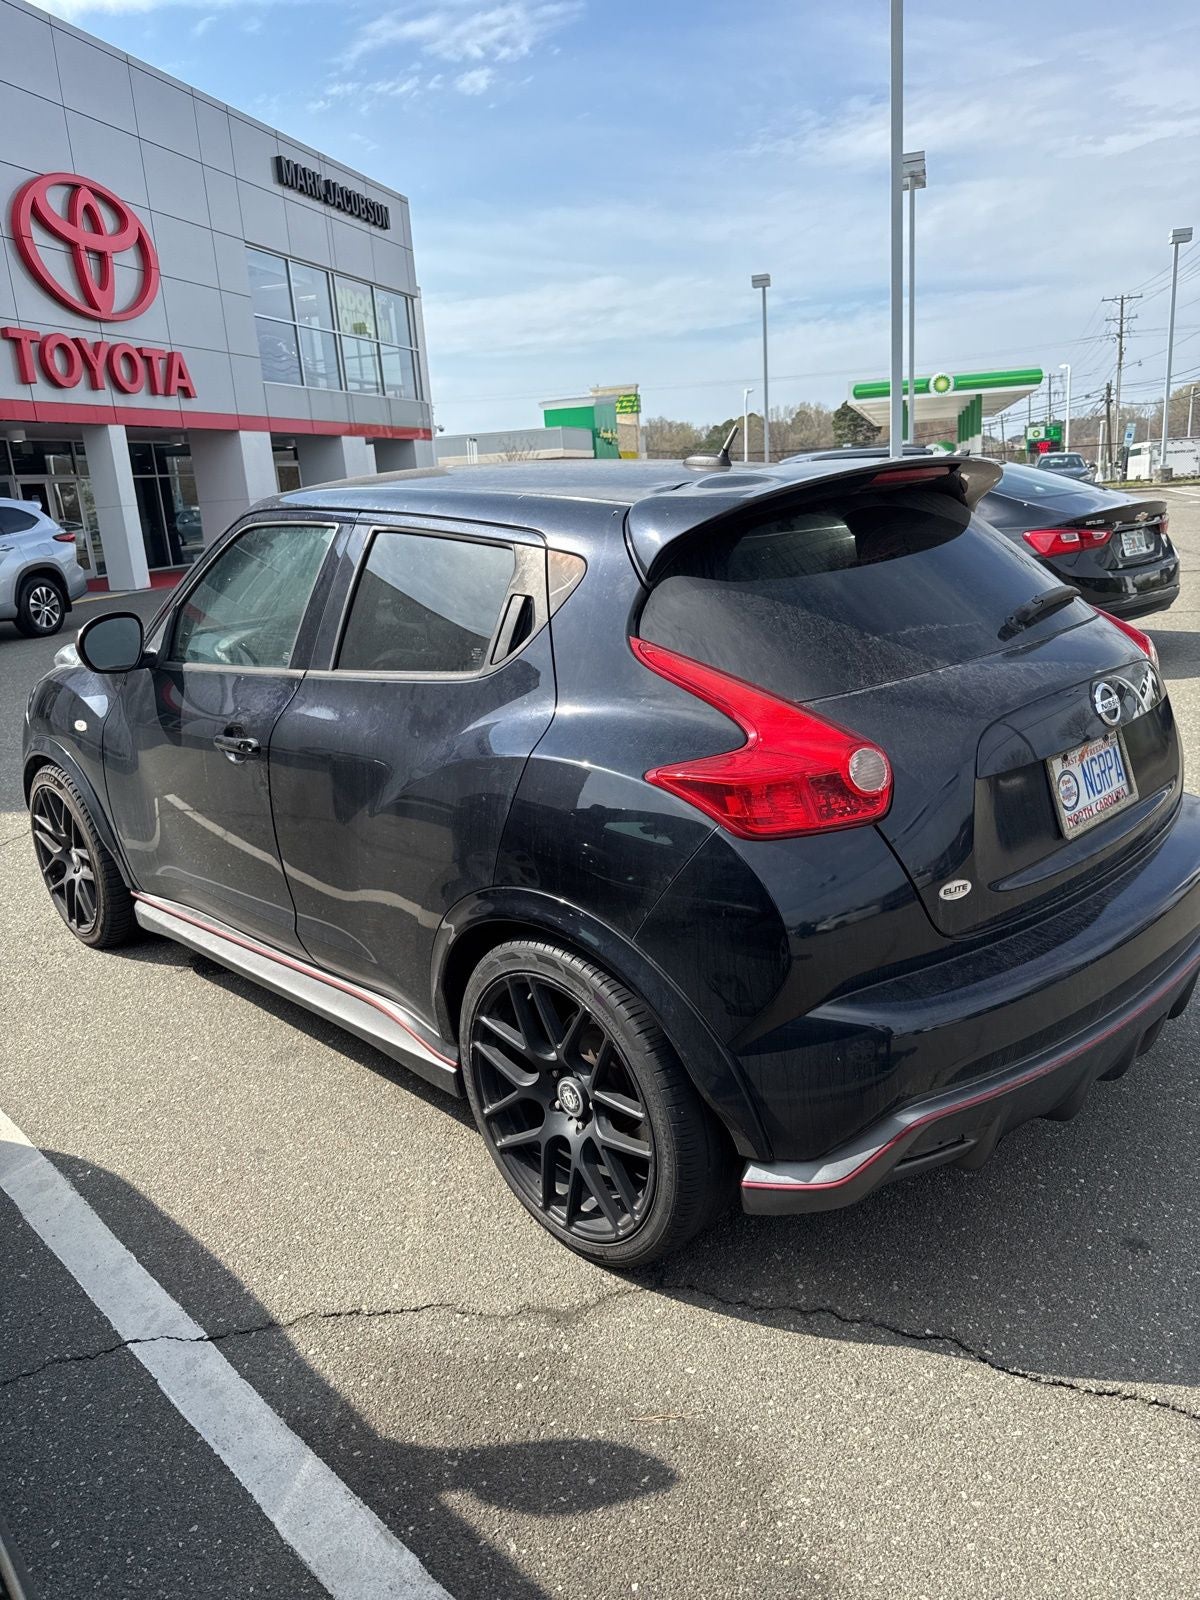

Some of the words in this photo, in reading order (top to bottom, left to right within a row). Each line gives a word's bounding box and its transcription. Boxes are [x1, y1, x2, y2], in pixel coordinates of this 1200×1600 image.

[275, 155, 325, 201] MARK
[324, 179, 391, 231] JACOBSON
[1, 326, 198, 399] TOYOTA
[1080, 745, 1125, 801] NGRPA
[1066, 804, 1095, 829] NORTH
[1095, 786, 1127, 813] CAROLINA
[943, 883, 968, 896] ELITE
